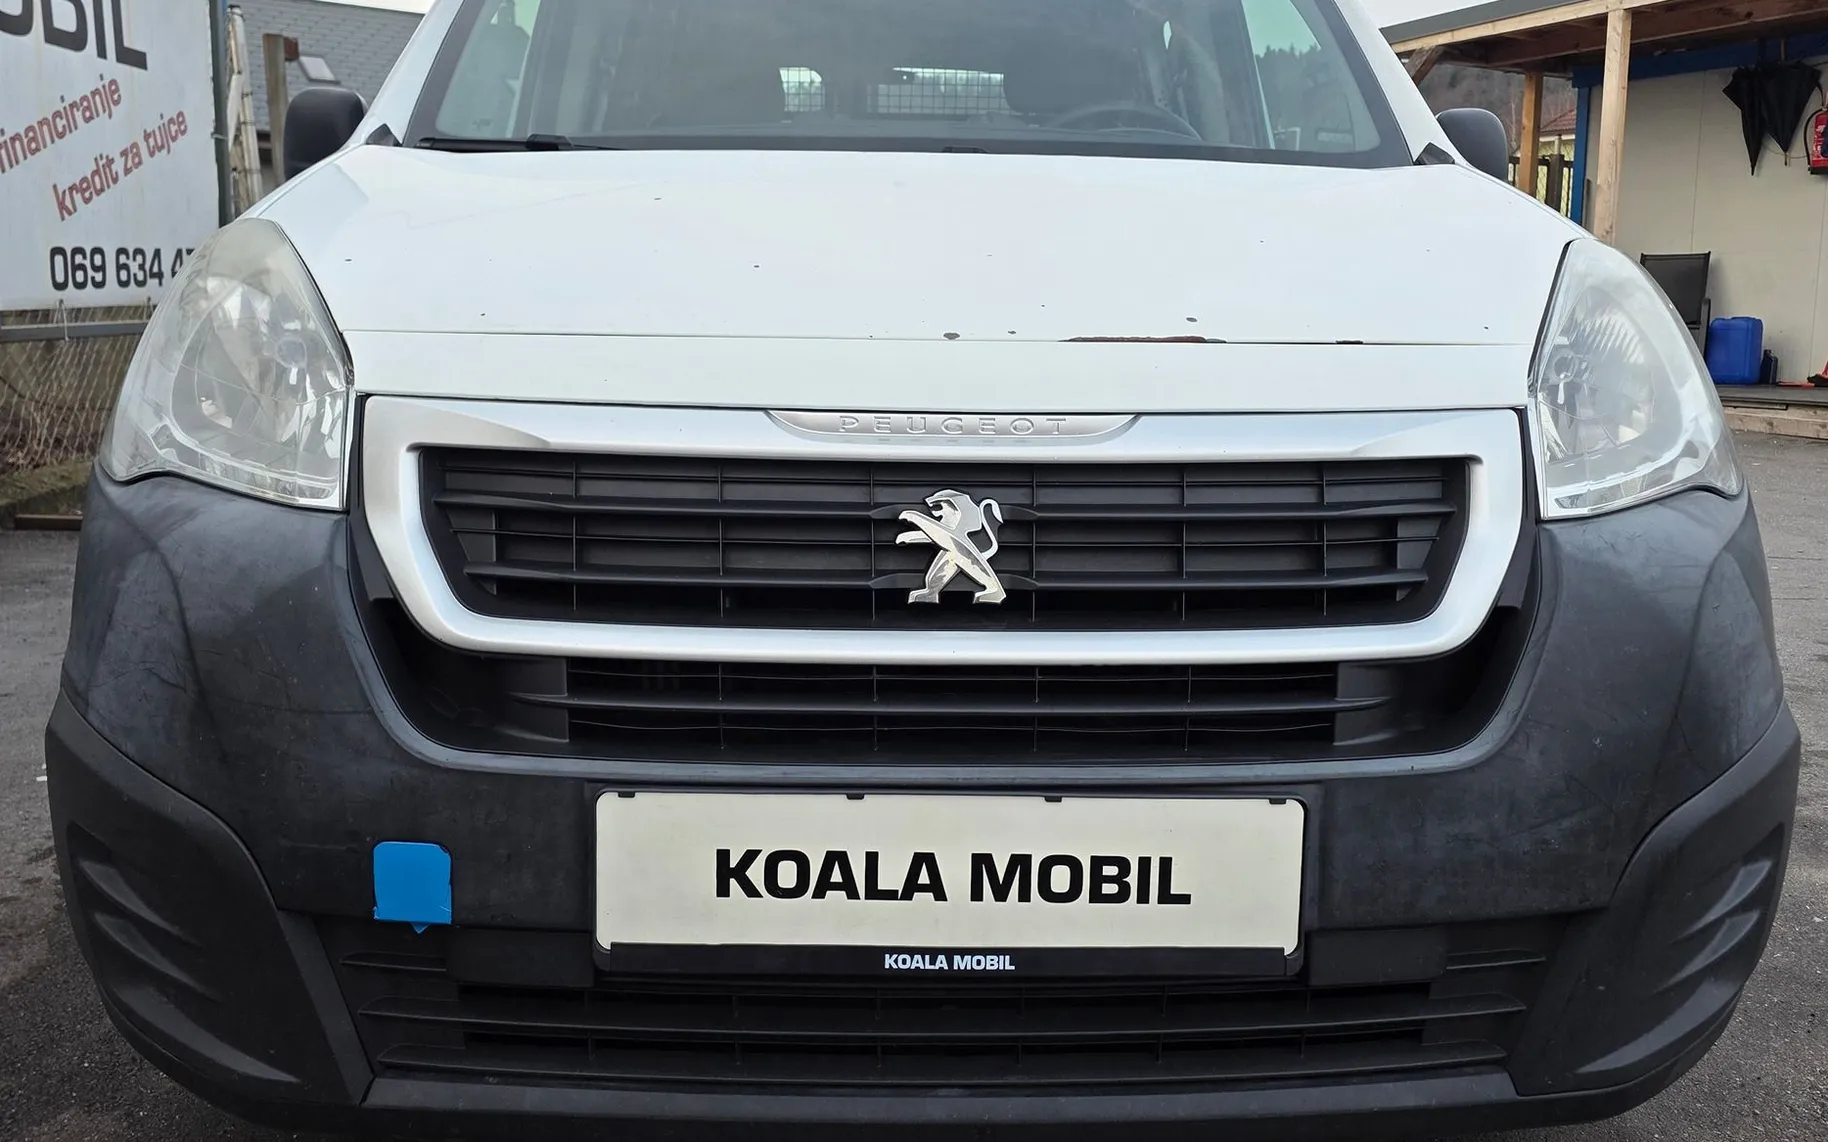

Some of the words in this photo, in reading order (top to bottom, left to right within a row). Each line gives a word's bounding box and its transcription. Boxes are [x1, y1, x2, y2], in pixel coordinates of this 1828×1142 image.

[52, 152, 119, 222] kredit
[119, 141, 143, 177] za
[143, 110, 188, 158] tujce
[50, 246, 107, 291] 069
[115, 247, 164, 288] 634
[171, 248, 196, 278] 4
[838, 416, 1067, 434] PEUGEOT
[715, 848, 948, 902] KOALA
[970, 852, 1191, 905] MOBIL
[884, 953, 949, 970] KOALA
[953, 954, 1016, 970] MOBIL
